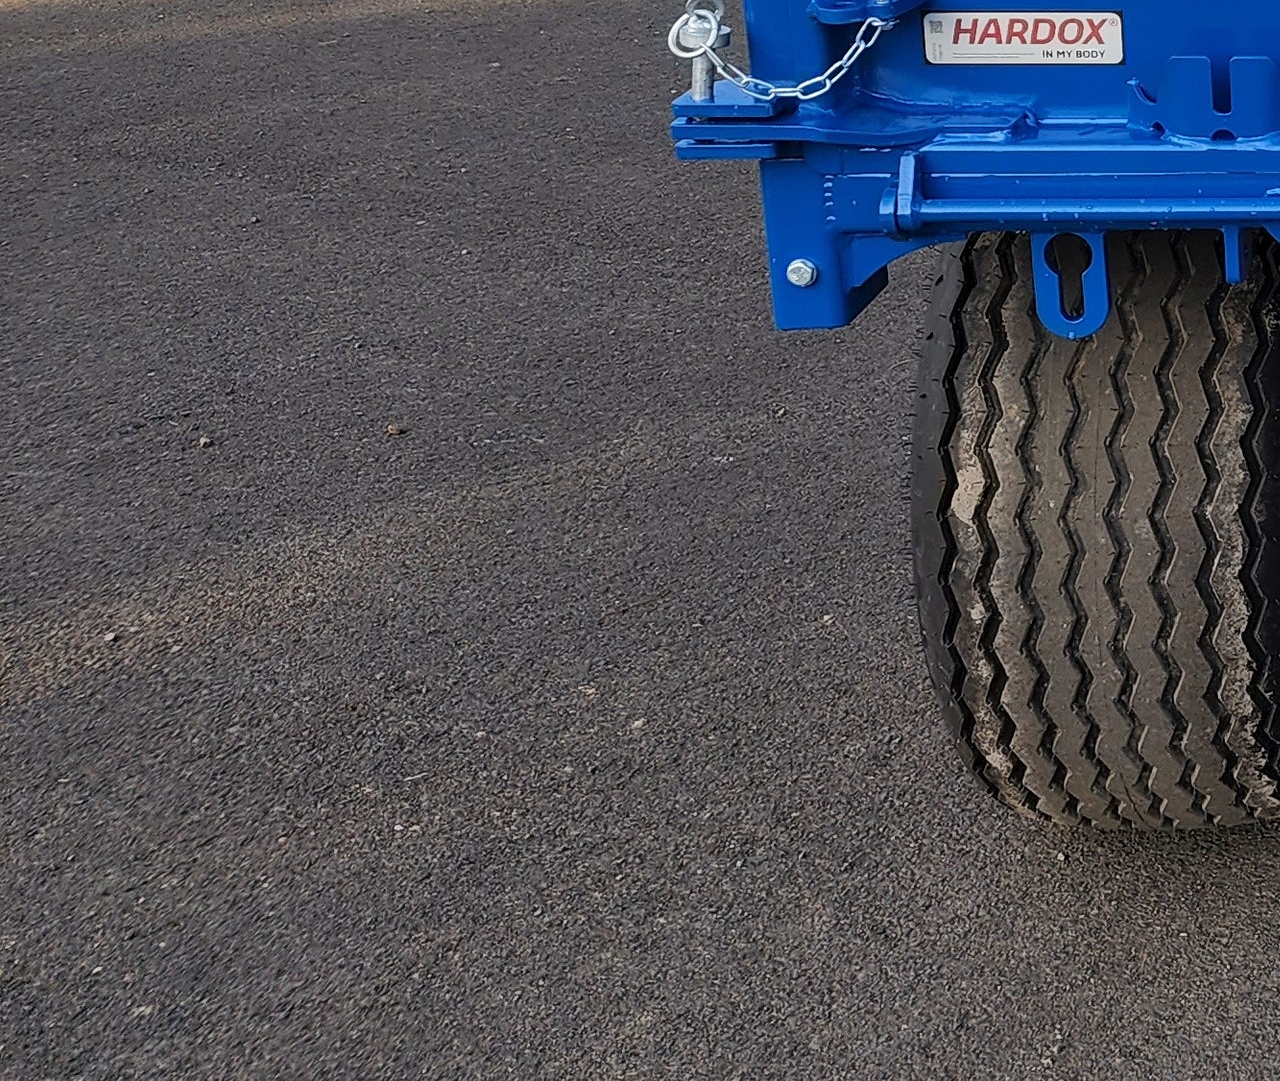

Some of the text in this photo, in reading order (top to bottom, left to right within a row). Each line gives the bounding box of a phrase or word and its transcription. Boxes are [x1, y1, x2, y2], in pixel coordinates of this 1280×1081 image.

[952, 18, 1109, 45] HARDOX
[1042, 50, 1053, 59] IN
[1057, 50, 1073, 59] MY
[1076, 50, 1106, 59] BODY
